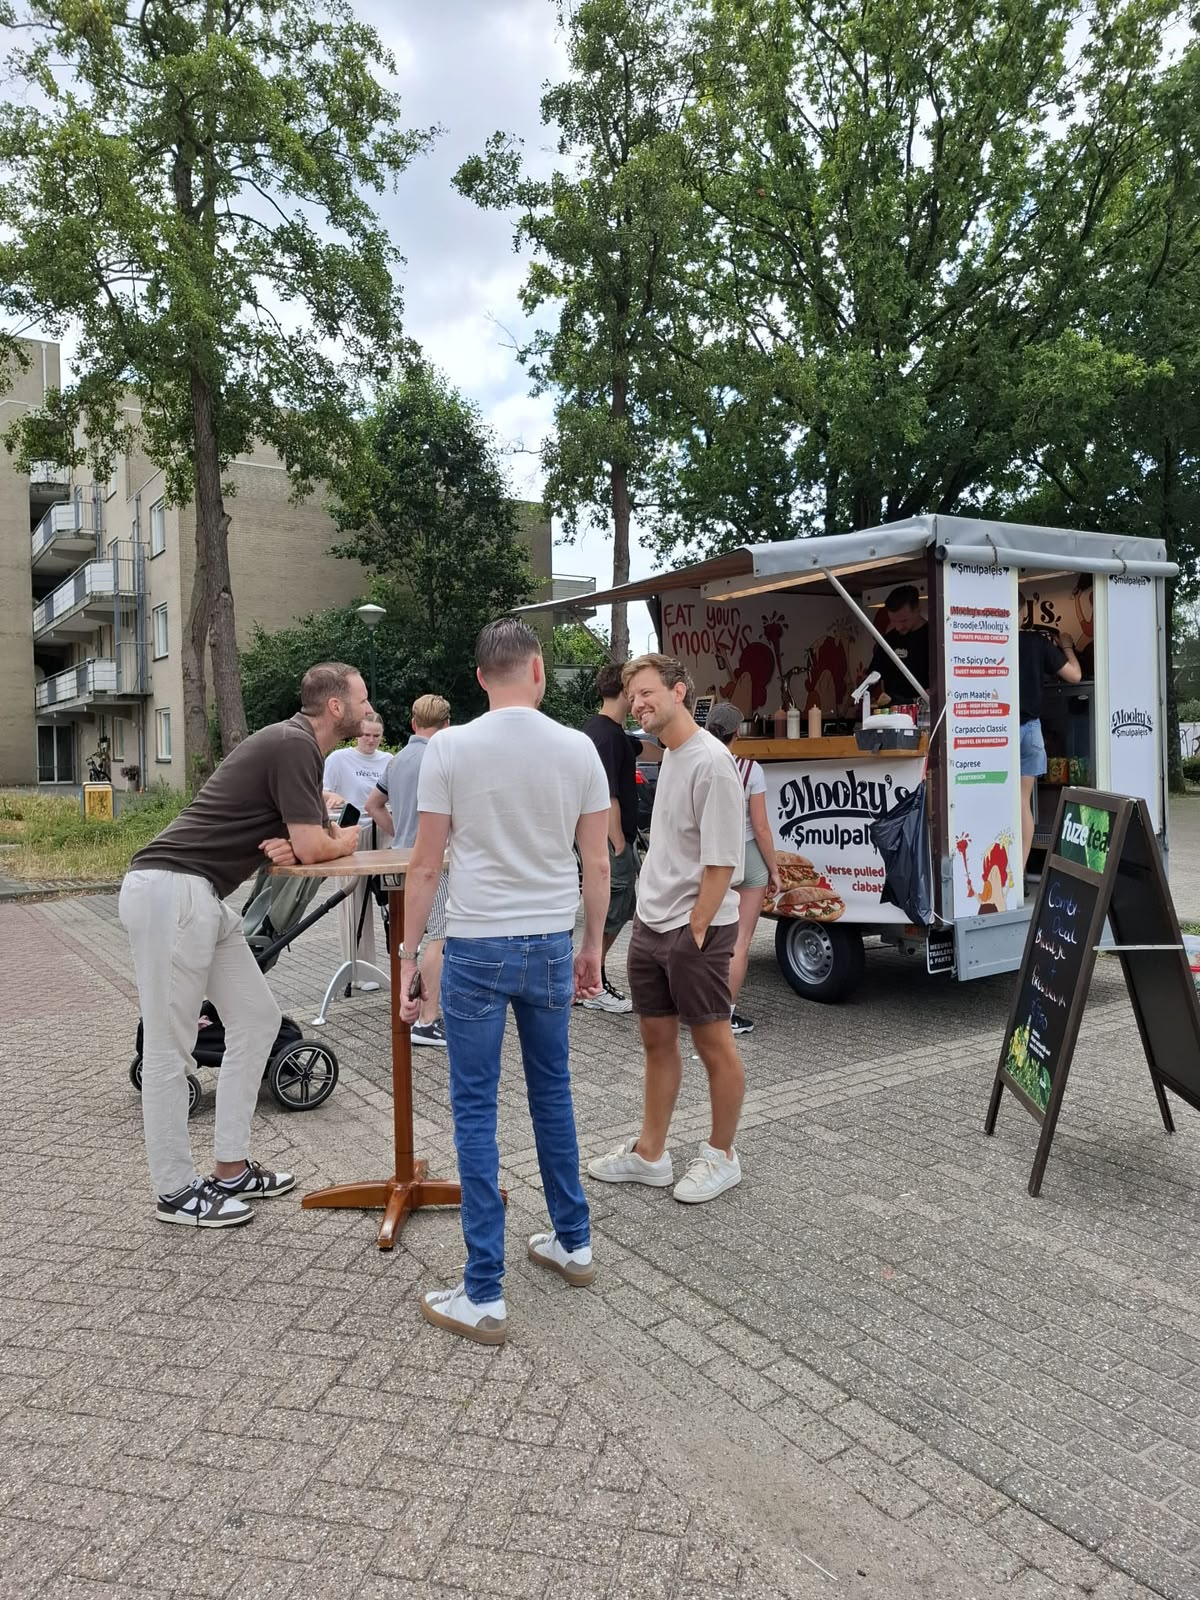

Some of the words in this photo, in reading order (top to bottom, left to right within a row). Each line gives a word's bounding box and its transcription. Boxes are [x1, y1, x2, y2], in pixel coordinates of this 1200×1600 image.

[957, 563, 1003, 577] Smulpaleis
[1113, 575, 1147, 586] Smulpaleis
[663, 603, 696, 628] EAT
[953, 621, 977, 631] Broodje
[979, 621, 1009, 632] Mooky's
[954, 656, 965, 664] The
[966, 656, 983, 665] Spicy
[984, 656, 997, 664] One
[954, 691, 969, 700] Gym
[969, 690, 991, 700] Maatje
[1110, 708, 1154, 727] Mooky's
[954, 725, 985, 735] Carpaccio
[986, 724, 1007, 733] Classic
[1116, 728, 1148, 737] Smulpaleis
[955, 760, 981, 769] Caprese
[794, 824, 873, 850] Smulpal
[825, 865, 852, 876] Verse
[854, 866, 885, 877] pulled
[852, 881, 885, 893] ciabat
